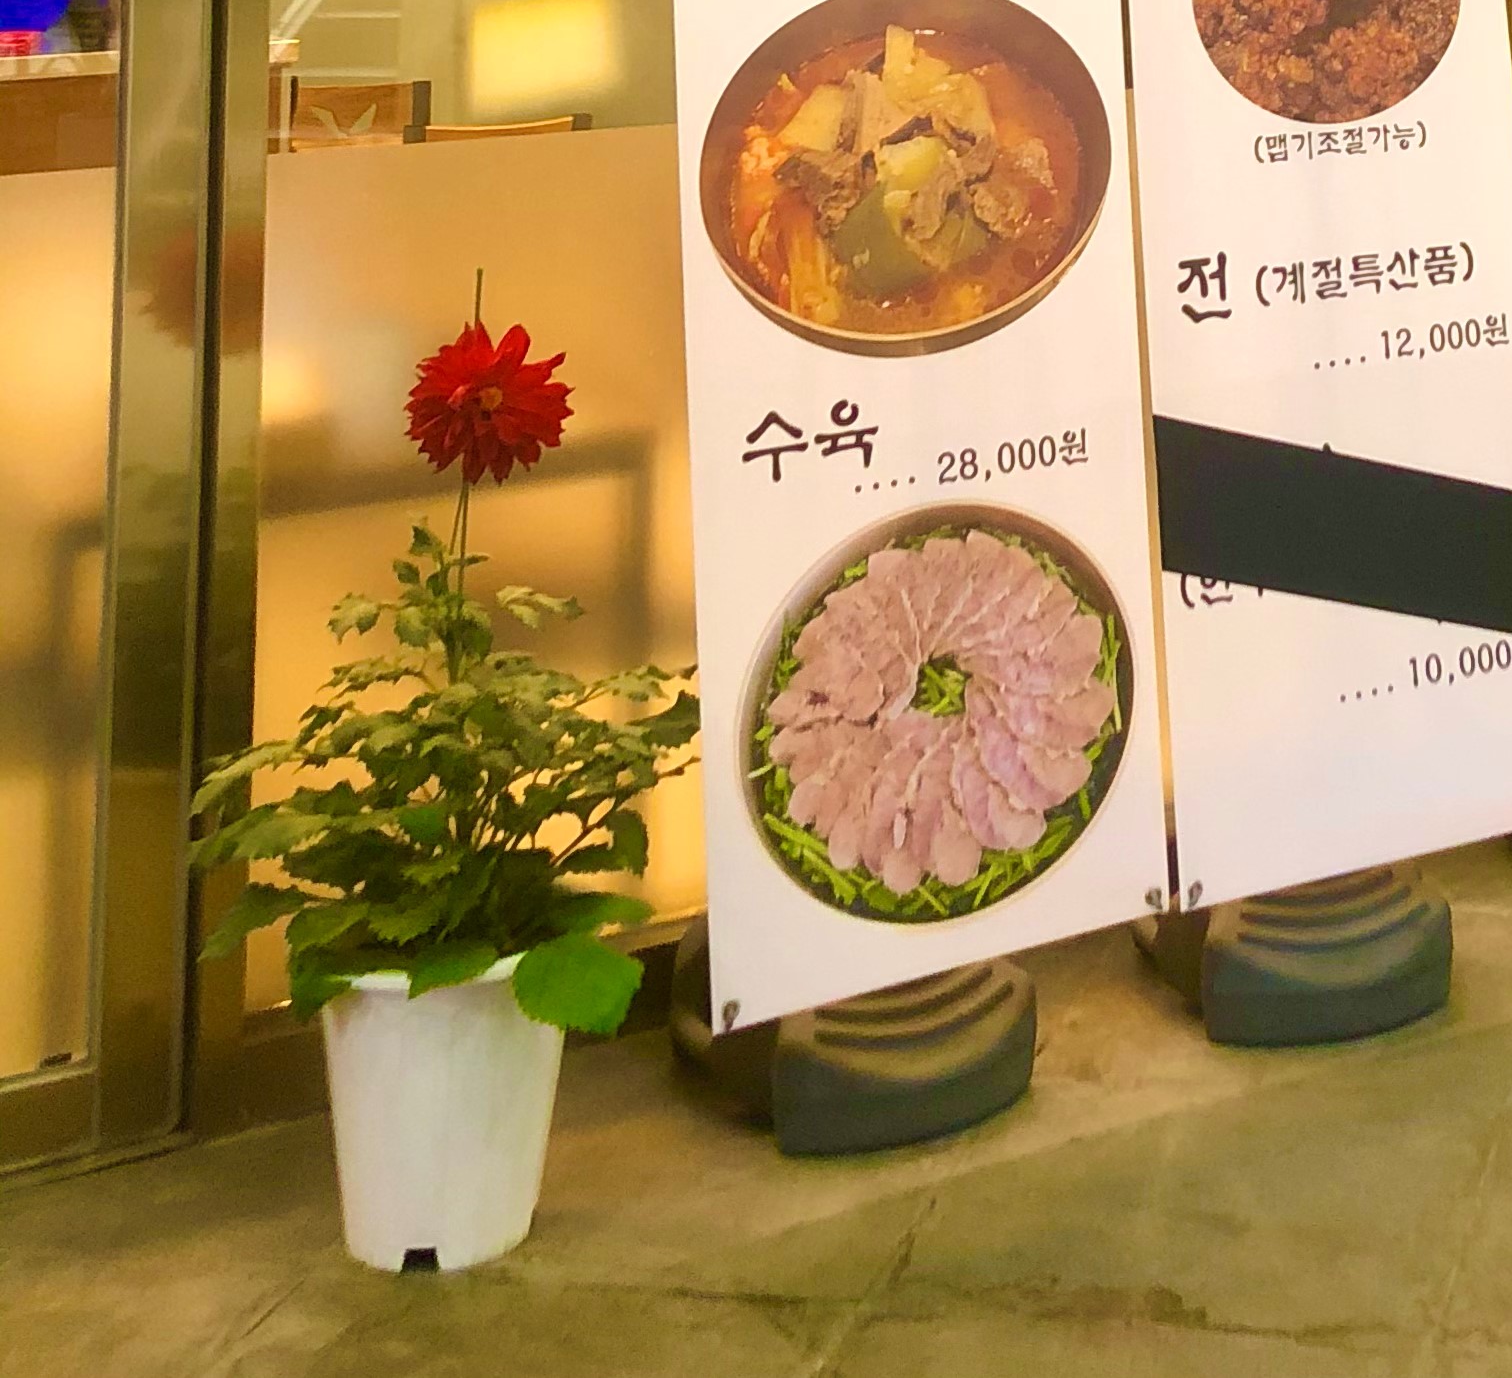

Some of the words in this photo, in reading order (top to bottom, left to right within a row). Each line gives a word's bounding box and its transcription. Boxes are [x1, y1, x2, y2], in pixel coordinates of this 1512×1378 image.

[1254, 120, 1426, 163] (맵기조절가능)
[1177, 251, 1232, 324] 전
[1256, 242, 1473, 307] (계절특산품)
[742, 399, 879, 482] 수육
